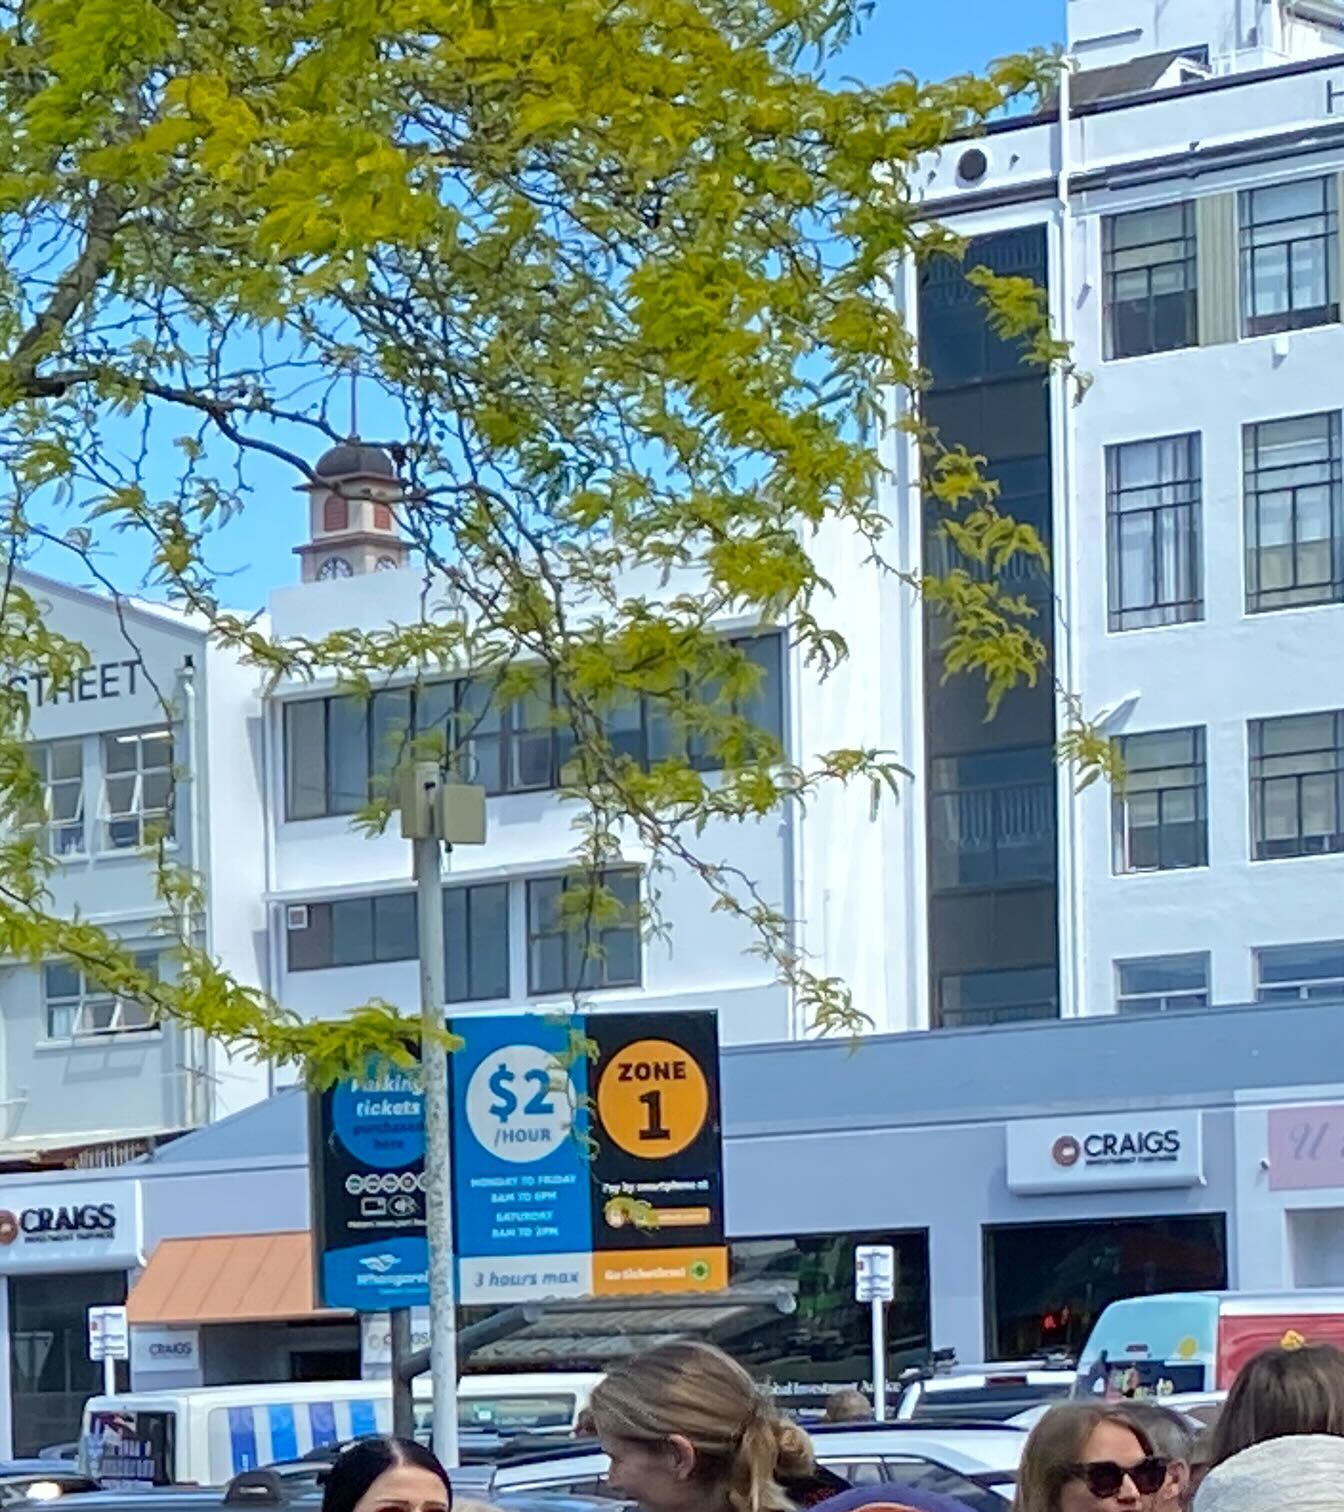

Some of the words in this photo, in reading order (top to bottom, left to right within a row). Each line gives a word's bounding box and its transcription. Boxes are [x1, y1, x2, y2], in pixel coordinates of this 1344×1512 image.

[618, 1061, 686, 1081] ZONE
[489, 1063, 555, 1123] $2
[356, 1098, 421, 1117] tickets
[638, 1090, 671, 1141] 1
[494, 1128, 552, 1147] /HOUR
[1084, 1129, 1181, 1157] CRAIGS
[20, 1203, 117, 1233] CRAIGS
[473, 1271, 484, 1287] 3
[488, 1271, 537, 1287] hours
[541, 1271, 580, 1284] max
